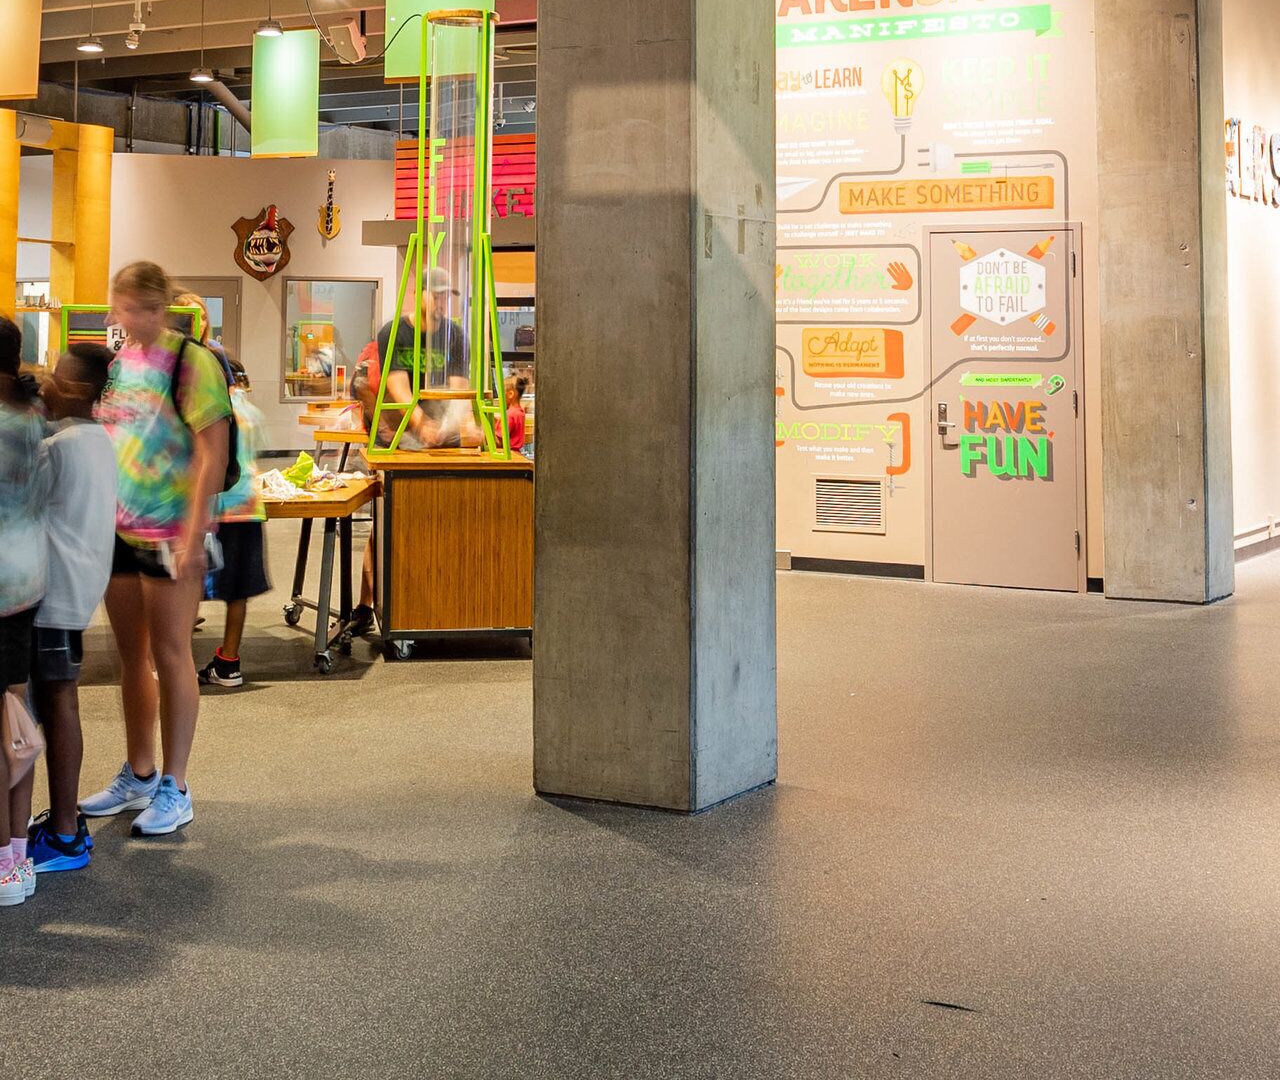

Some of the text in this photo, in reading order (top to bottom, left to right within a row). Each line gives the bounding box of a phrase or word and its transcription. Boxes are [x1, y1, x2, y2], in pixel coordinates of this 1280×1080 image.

[790, 11, 1021, 43] MANIFESTO
[776, 70, 801, 92] ay
[814, 67, 863, 89] LEARN
[1026, 52, 1055, 81] IT
[776, 106, 869, 134] MAGINE
[427, 138, 447, 270] FLY
[849, 181, 1040, 207] MAKE SOMETHING
[793, 253, 881, 269] WORK
[977, 261, 1027, 275] DON'T BE
[783, 256, 892, 297] together
[974, 275, 1031, 295] AFRAID
[976, 295, 1028, 313] TO FAIL
[807, 331, 879, 362] Adapt
[976, 335, 989, 343] first
[1000, 335, 1016, 343] don't
[988, 344, 1015, 352] perfectly
[1015, 344, 1039, 352] normal.
[963, 400, 1043, 431] HAVE
[776, 422, 901, 441] MODIFY
[959, 434, 1049, 478] FUN
